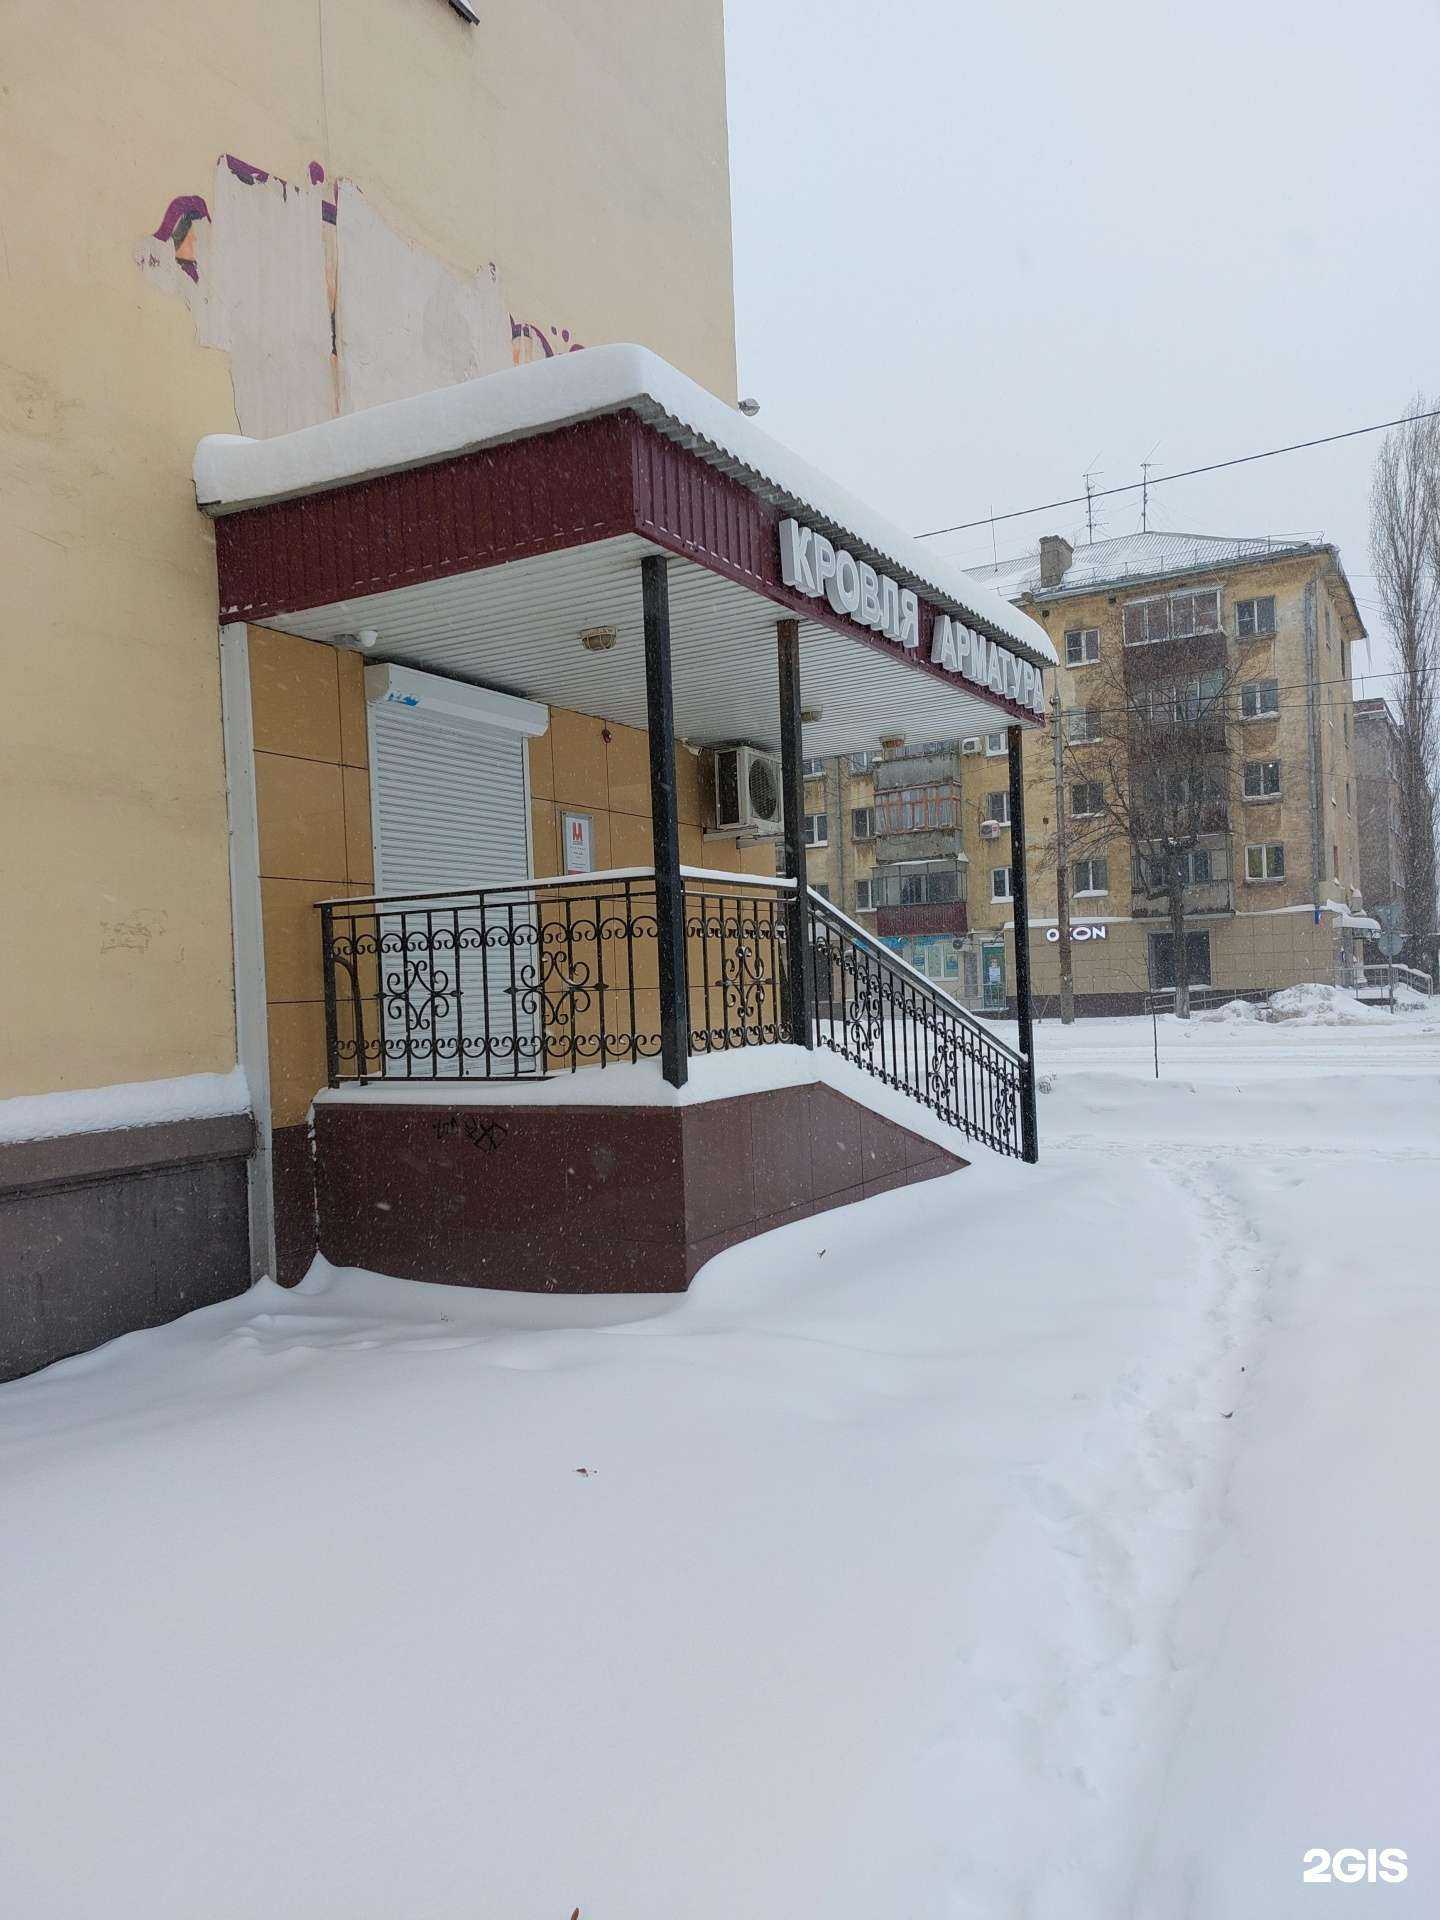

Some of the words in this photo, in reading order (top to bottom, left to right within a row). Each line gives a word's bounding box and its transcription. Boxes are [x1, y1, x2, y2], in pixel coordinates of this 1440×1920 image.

[779, 518, 919, 648] КРОВЛЯ
[931, 614, 1045, 714] АРМАТУРА
[1046, 926, 1106, 942] OON
